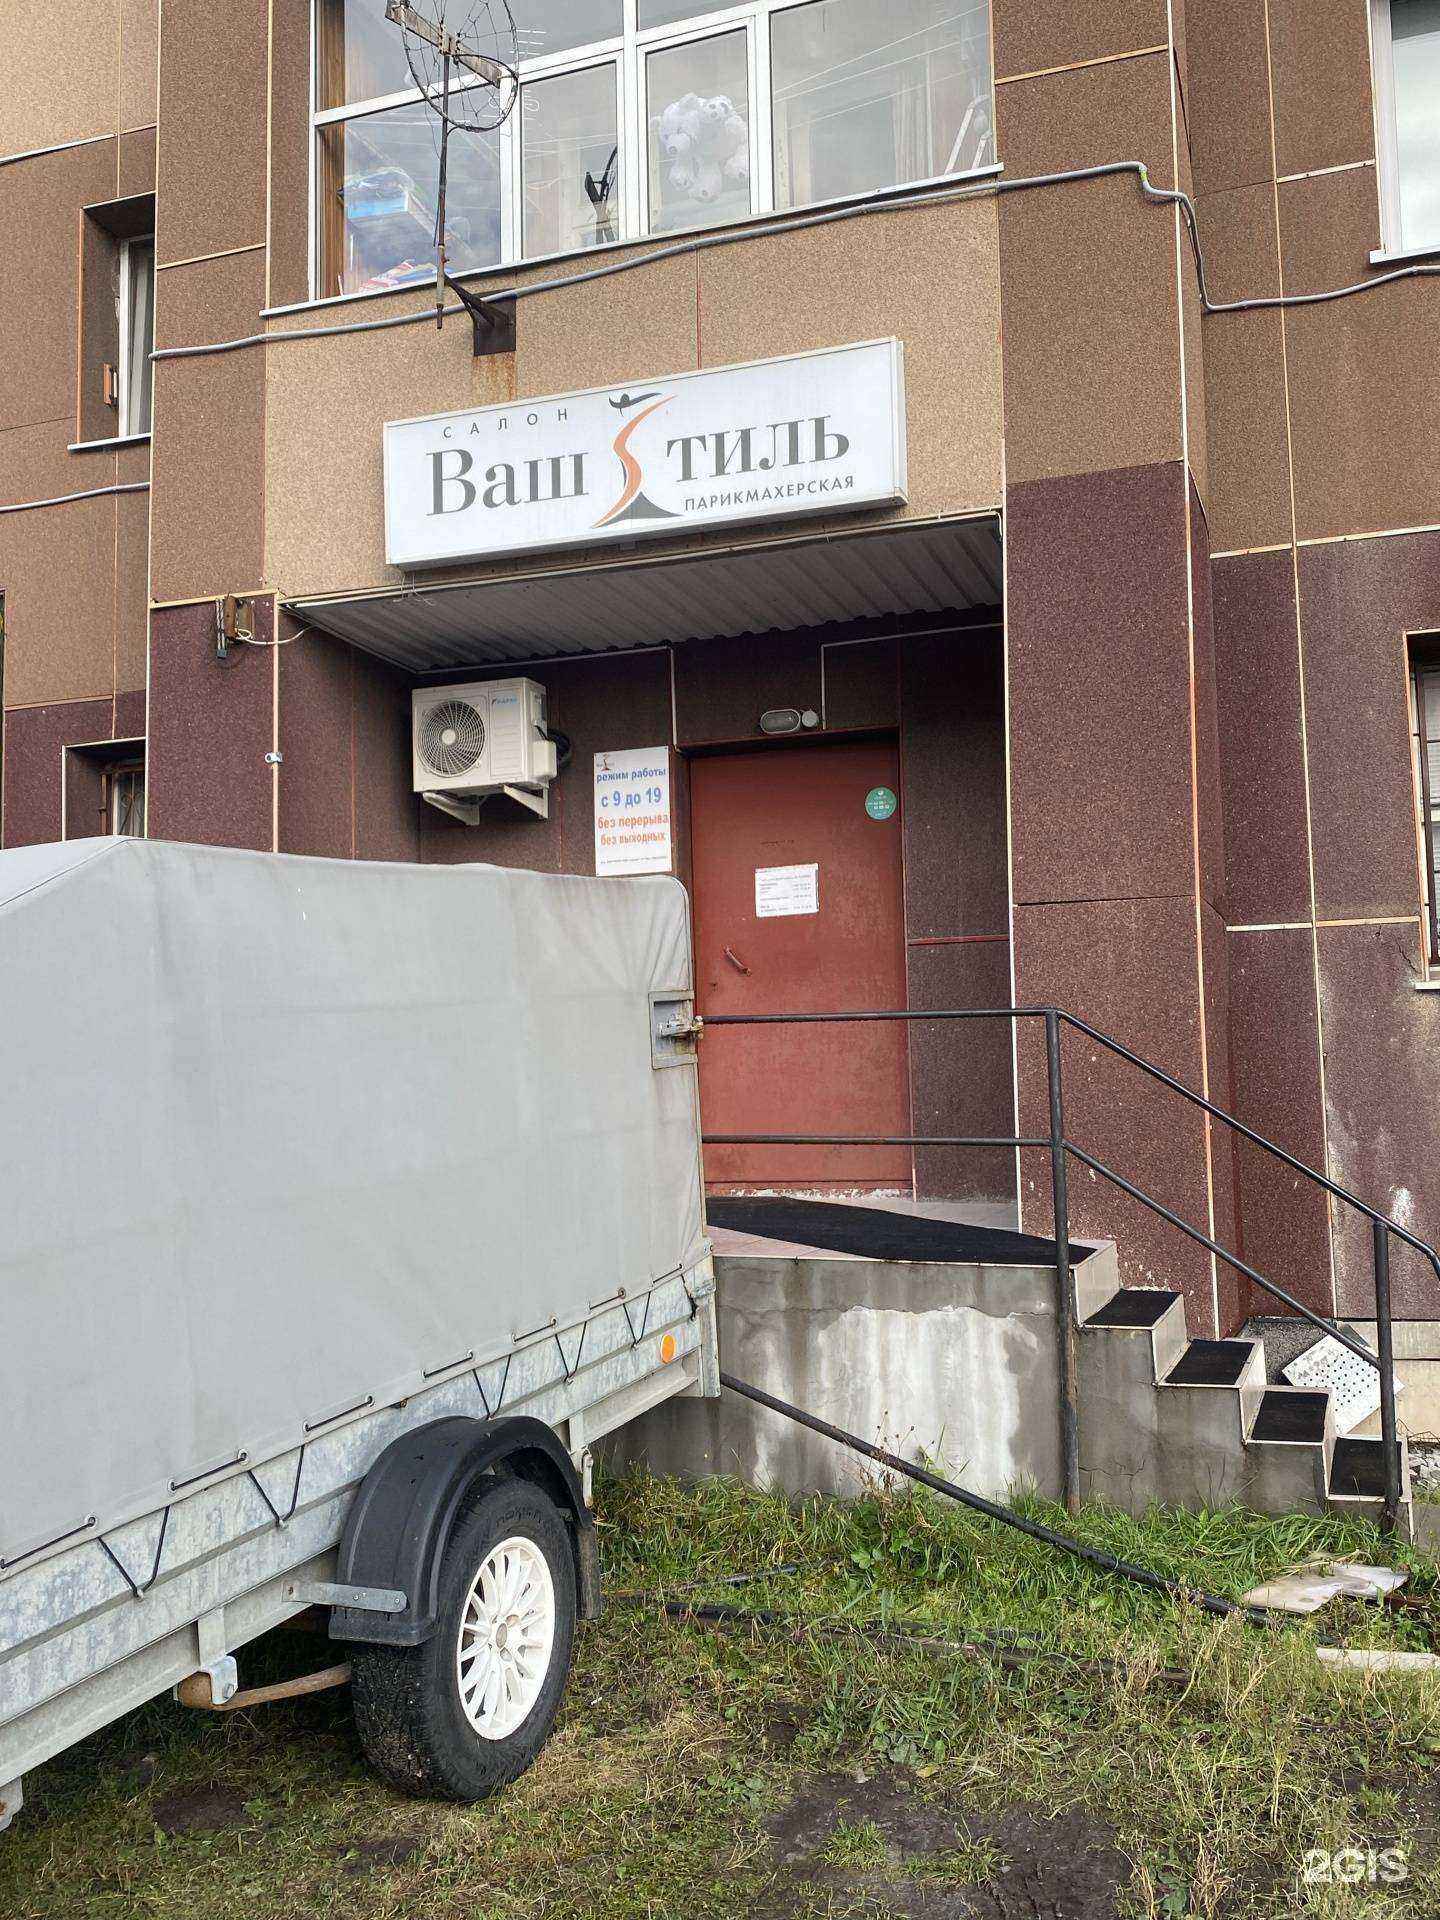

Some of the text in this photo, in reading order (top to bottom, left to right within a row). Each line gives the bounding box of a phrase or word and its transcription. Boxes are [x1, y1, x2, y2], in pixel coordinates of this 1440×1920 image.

[443, 408, 569, 439] САЛОН
[426, 448, 590, 516] Ваш
[684, 475, 855, 512] ПАРИКМАХЕРСКАЯ
[596, 767, 667, 783] режим работы
[613, 790, 622, 806] 9
[625, 793, 641, 808] до
[645, 787, 662, 804] 19
[597, 814, 668, 829] без перерыва
[600, 831, 666, 846] без выходных
